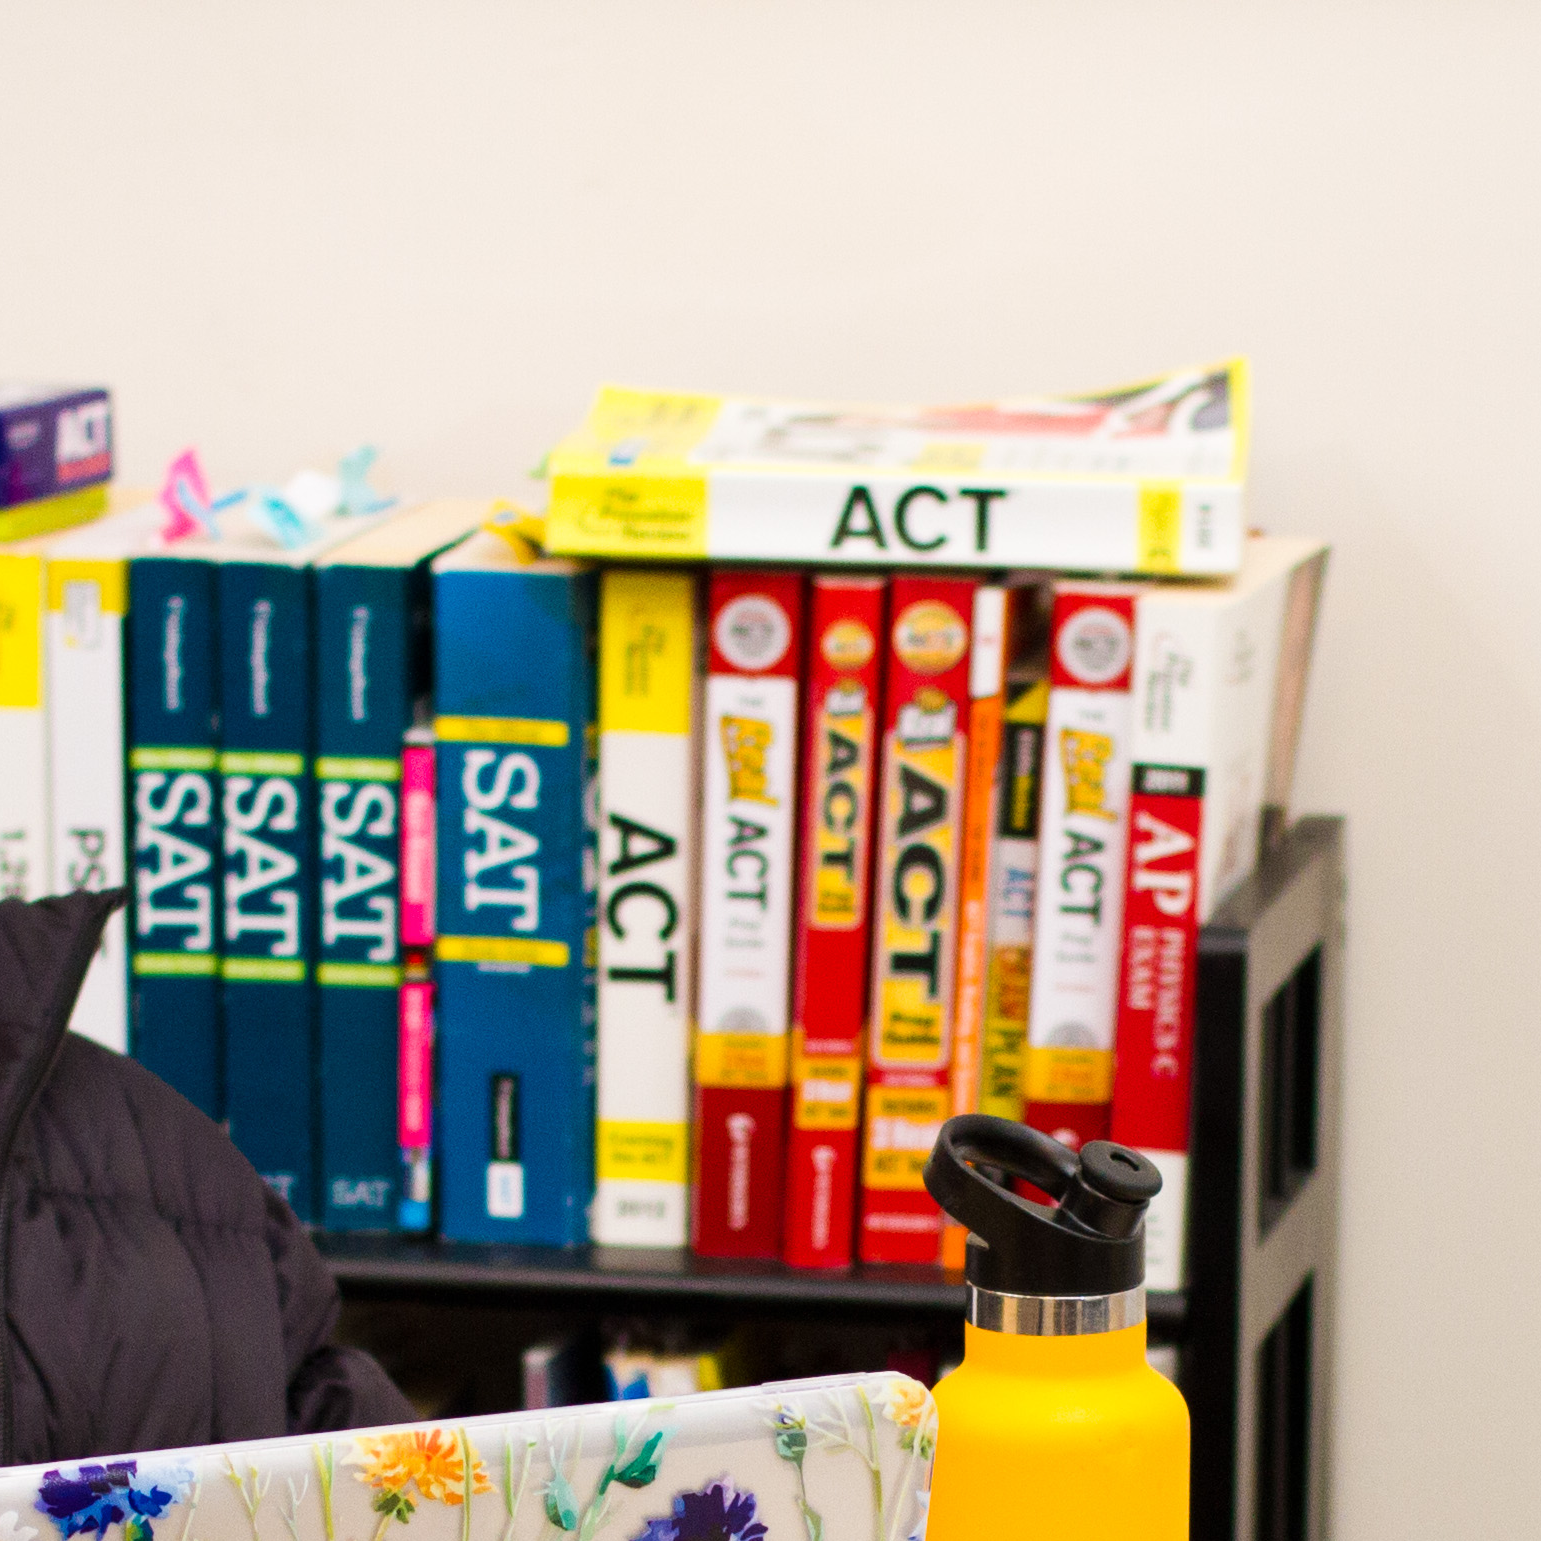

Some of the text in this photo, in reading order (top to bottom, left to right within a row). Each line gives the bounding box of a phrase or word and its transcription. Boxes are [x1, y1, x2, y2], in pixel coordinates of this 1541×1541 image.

[829, 484, 1009, 553] ACT
[719, 715, 780, 808] Real
[820, 729, 860, 888] ACT
[1061, 728, 1118, 823] Real
[135, 774, 211, 950] SAT
[223, 777, 300, 957] SAT
[320, 782, 396, 963] SAT
[462, 750, 541, 933] SAT
[725, 815, 769, 914] ACT
[889, 763, 948, 998] ACT
[1003, 867, 1034, 919] ACT
[1057, 829, 1105, 926] ACT
[1133, 811, 1194, 916] AP
[607, 812, 678, 1003] ACT
[332, 1178, 390, 1206] SAT
